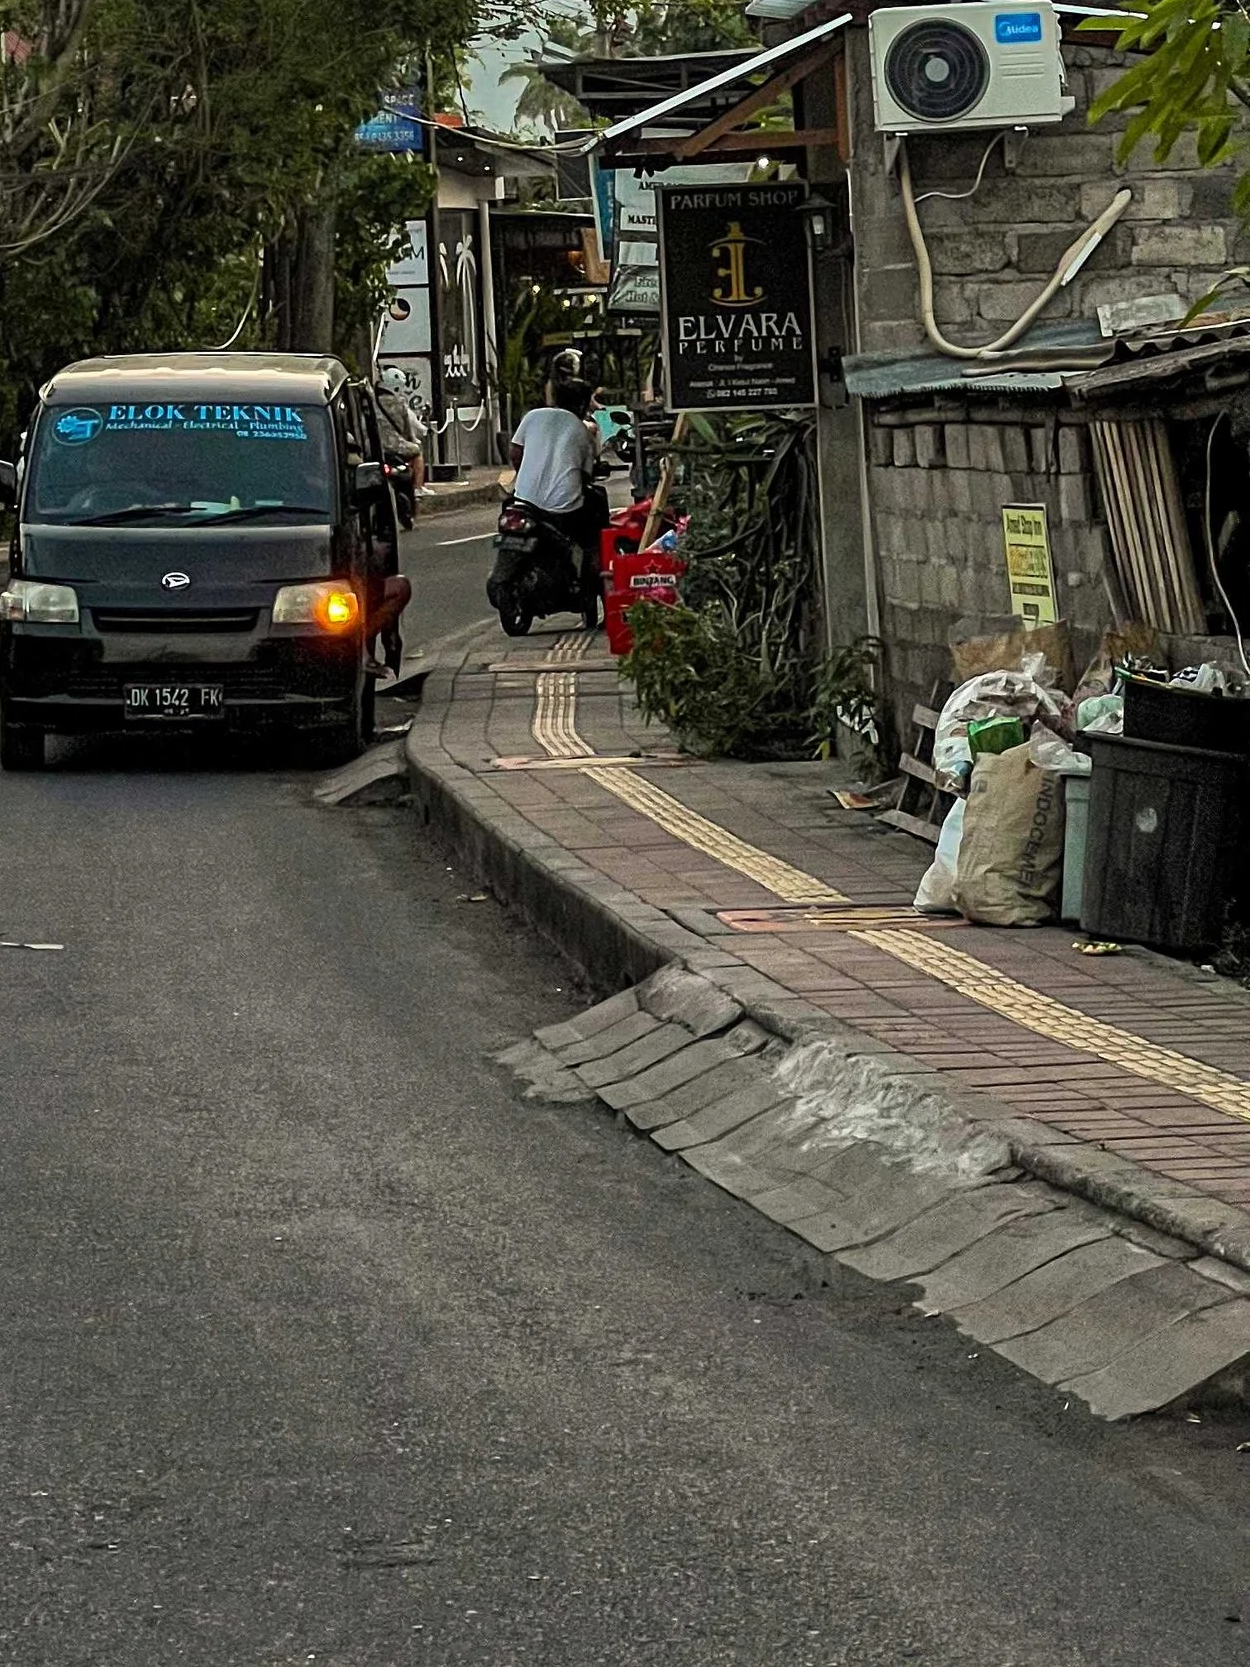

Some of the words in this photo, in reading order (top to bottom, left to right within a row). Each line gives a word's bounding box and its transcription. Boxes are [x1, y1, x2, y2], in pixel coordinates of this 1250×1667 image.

[670, 193, 742, 210] PARFUM
[748, 191, 799, 206] SHOP
[678, 312, 802, 340] ELVARA
[679, 338, 803, 354] PERFUME
[109, 404, 185, 420] ELOK
[194, 405, 303, 422] TEKNIK
[105, 419, 172, 430] Mechanical
[183, 419, 239, 430] Electrical
[249, 421, 305, 434] Plumbing
[632, 575, 675, 587] BINTANG
[131, 688, 149, 707] DK
[155, 688, 190, 707] 1542
[201, 688, 219, 707] FK
